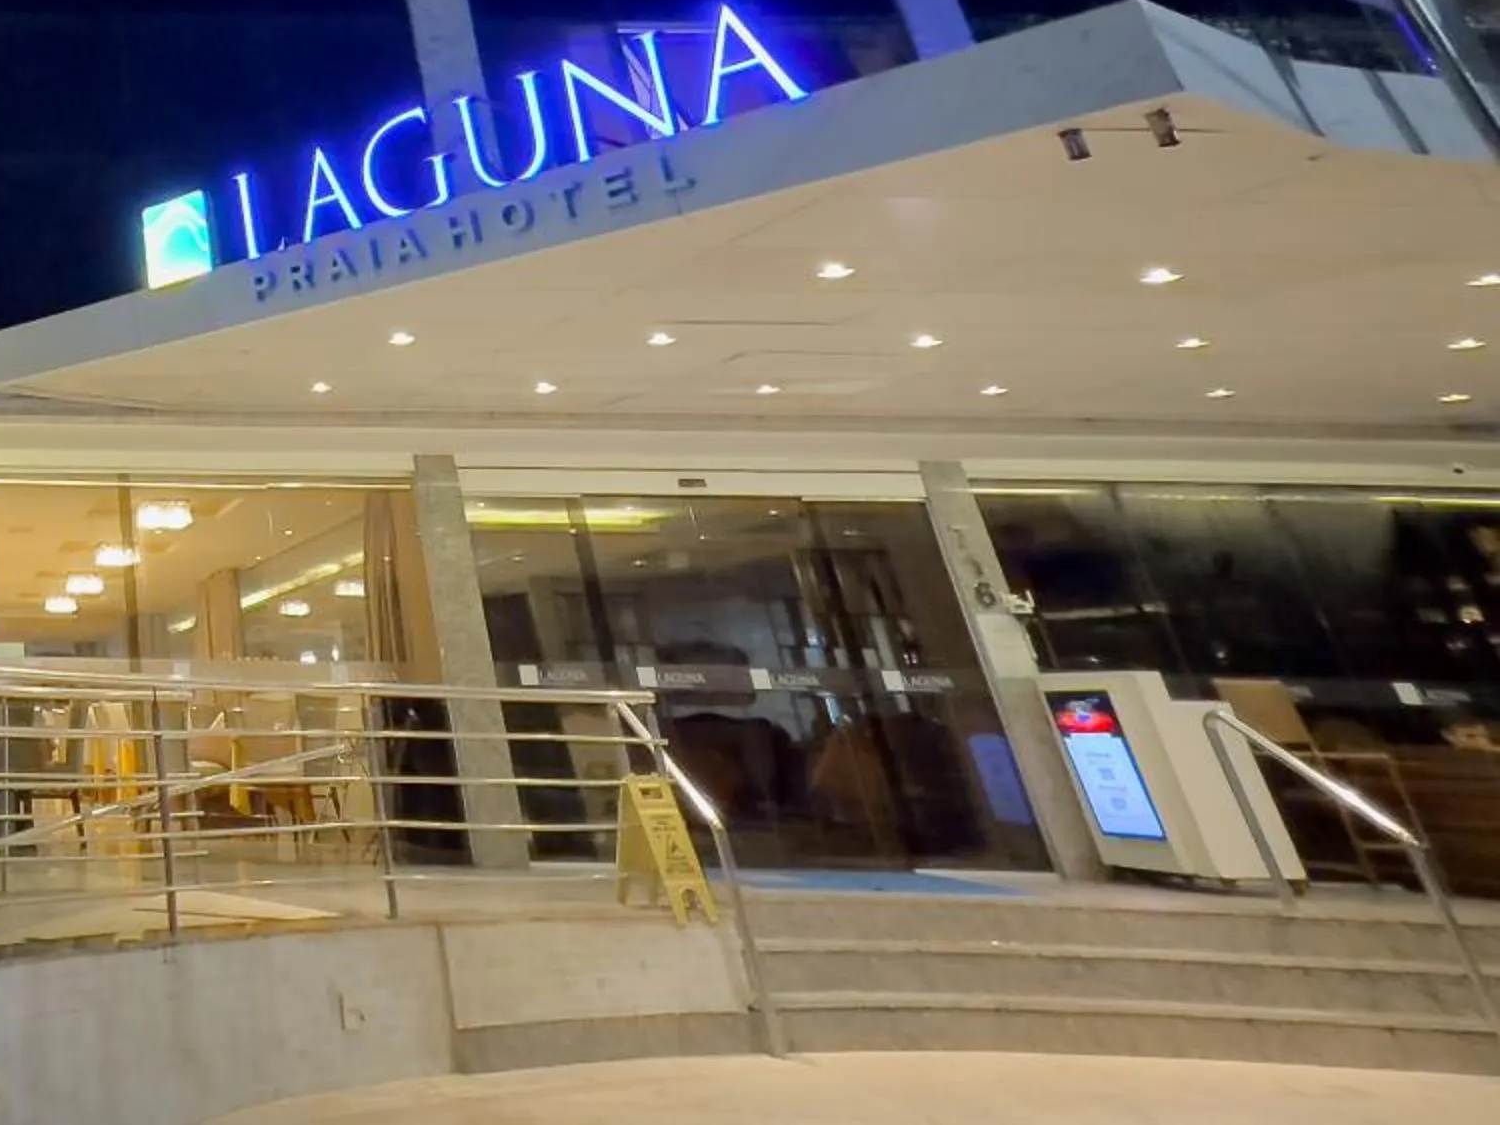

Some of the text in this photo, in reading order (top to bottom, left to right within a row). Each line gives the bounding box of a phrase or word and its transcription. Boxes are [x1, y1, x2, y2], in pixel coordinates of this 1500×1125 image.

[230, 2, 809, 262] LAGUNA
[252, 155, 698, 302] PRAIA HOTEL
